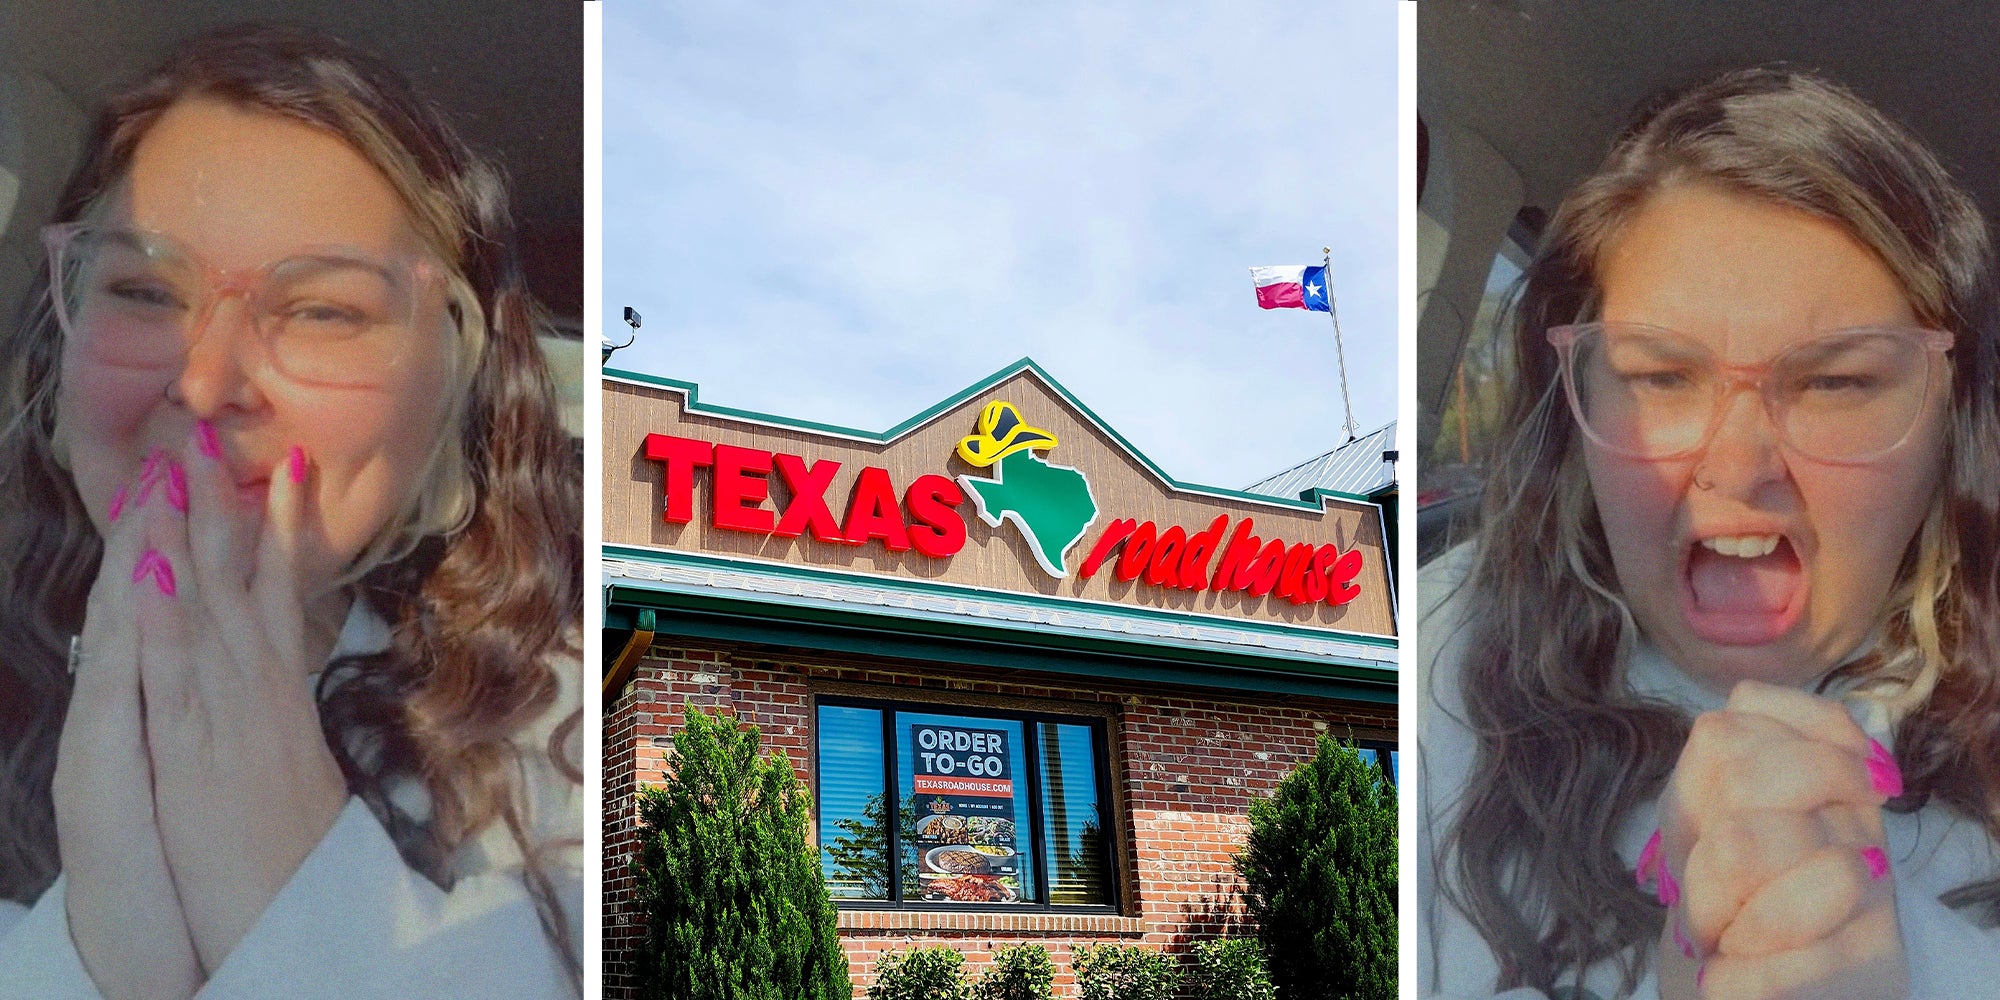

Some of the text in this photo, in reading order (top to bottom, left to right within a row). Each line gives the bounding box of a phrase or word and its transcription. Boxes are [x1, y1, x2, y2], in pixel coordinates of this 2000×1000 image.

[644, 433, 967, 559] TEXAS
[918, 729, 1003, 754] ORDER
[920, 752, 1003, 777] TO-GO
[916, 779, 1011, 793] TEXASROADHOUSE.COM
